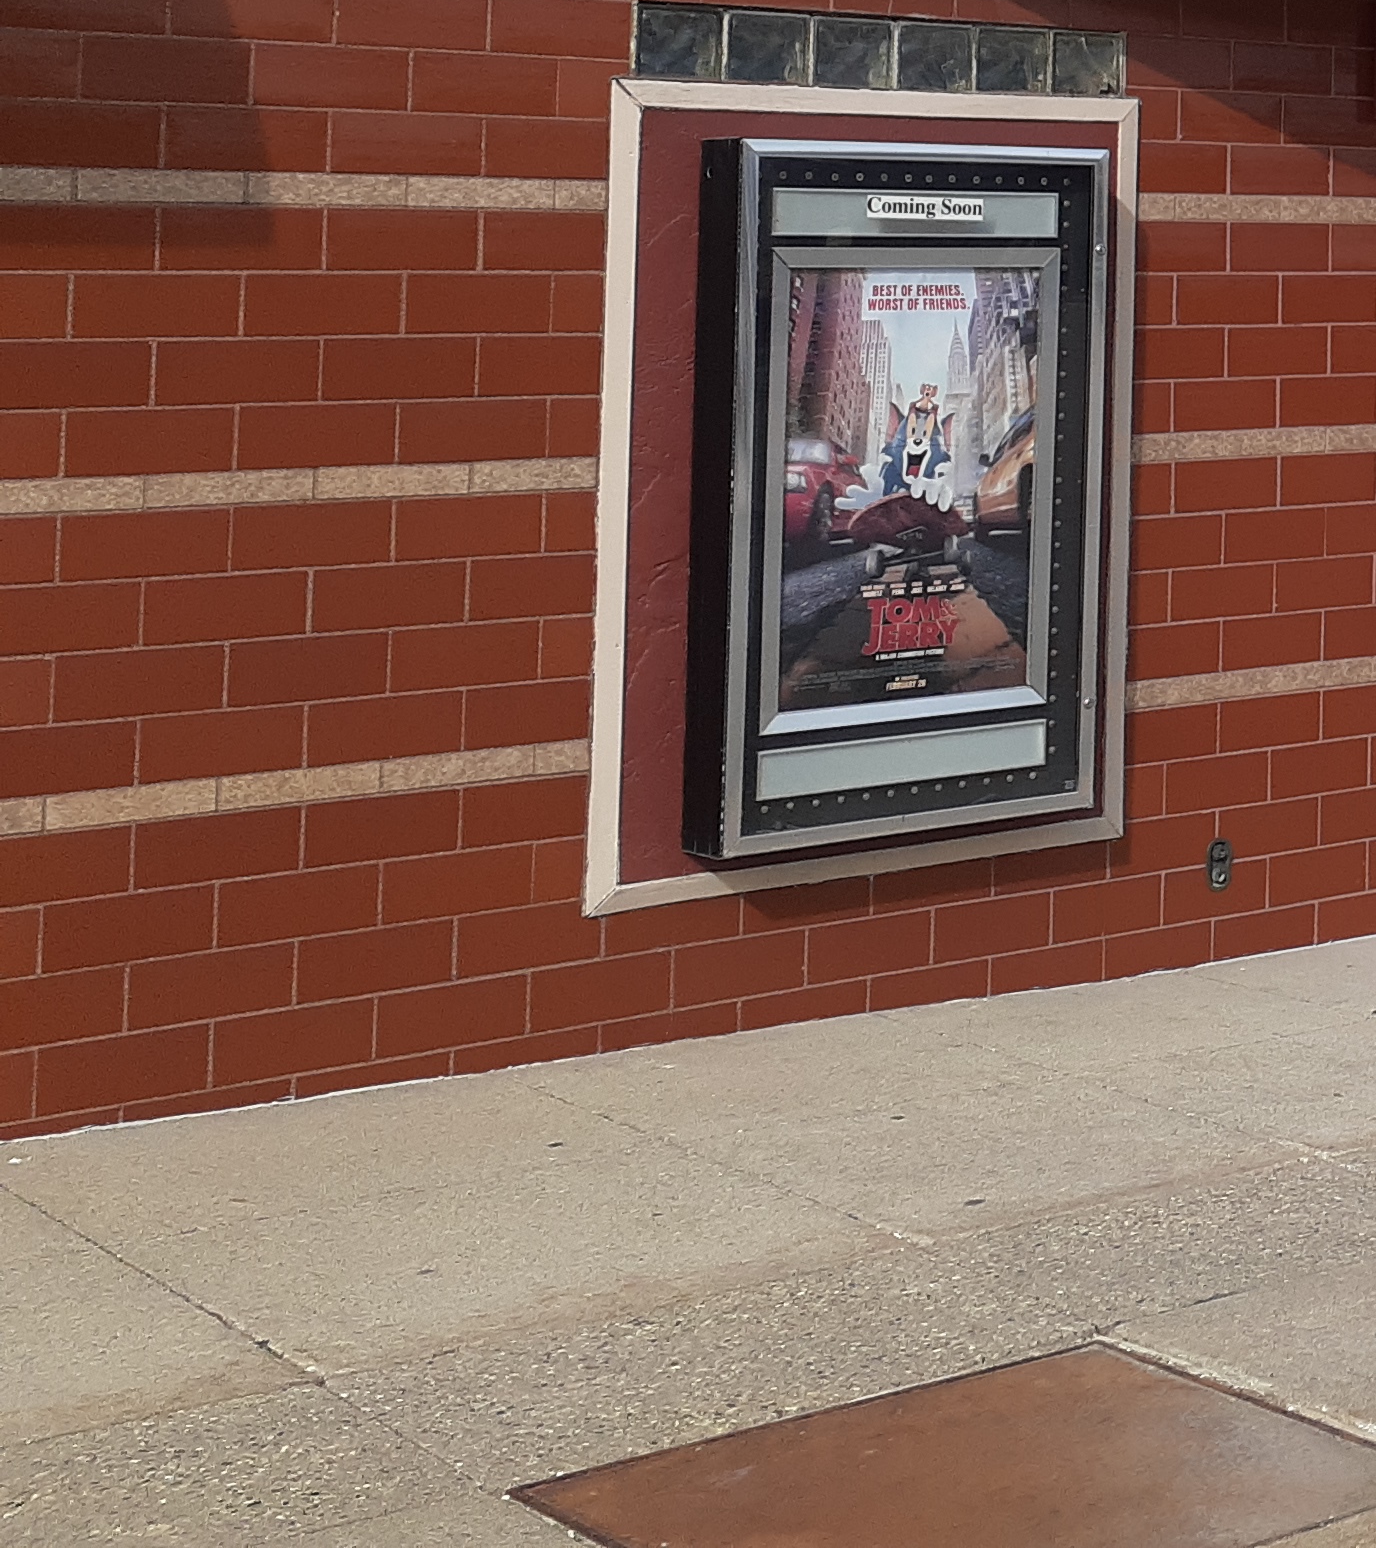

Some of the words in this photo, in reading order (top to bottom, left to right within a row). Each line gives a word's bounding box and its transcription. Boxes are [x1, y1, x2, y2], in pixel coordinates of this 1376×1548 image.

[867, 196, 937, 219] Coming
[941, 198, 983, 216] Soon
[872, 285, 898, 297] BEST
[901, 285, 913, 296] OF
[916, 284, 965, 297] ENEMIES.
[867, 298, 904, 311] WORST
[907, 299, 920, 311] OF
[922, 298, 971, 311] FRIENDS.
[867, 595, 941, 626] TOM
[861, 618, 960, 656] JERRY
